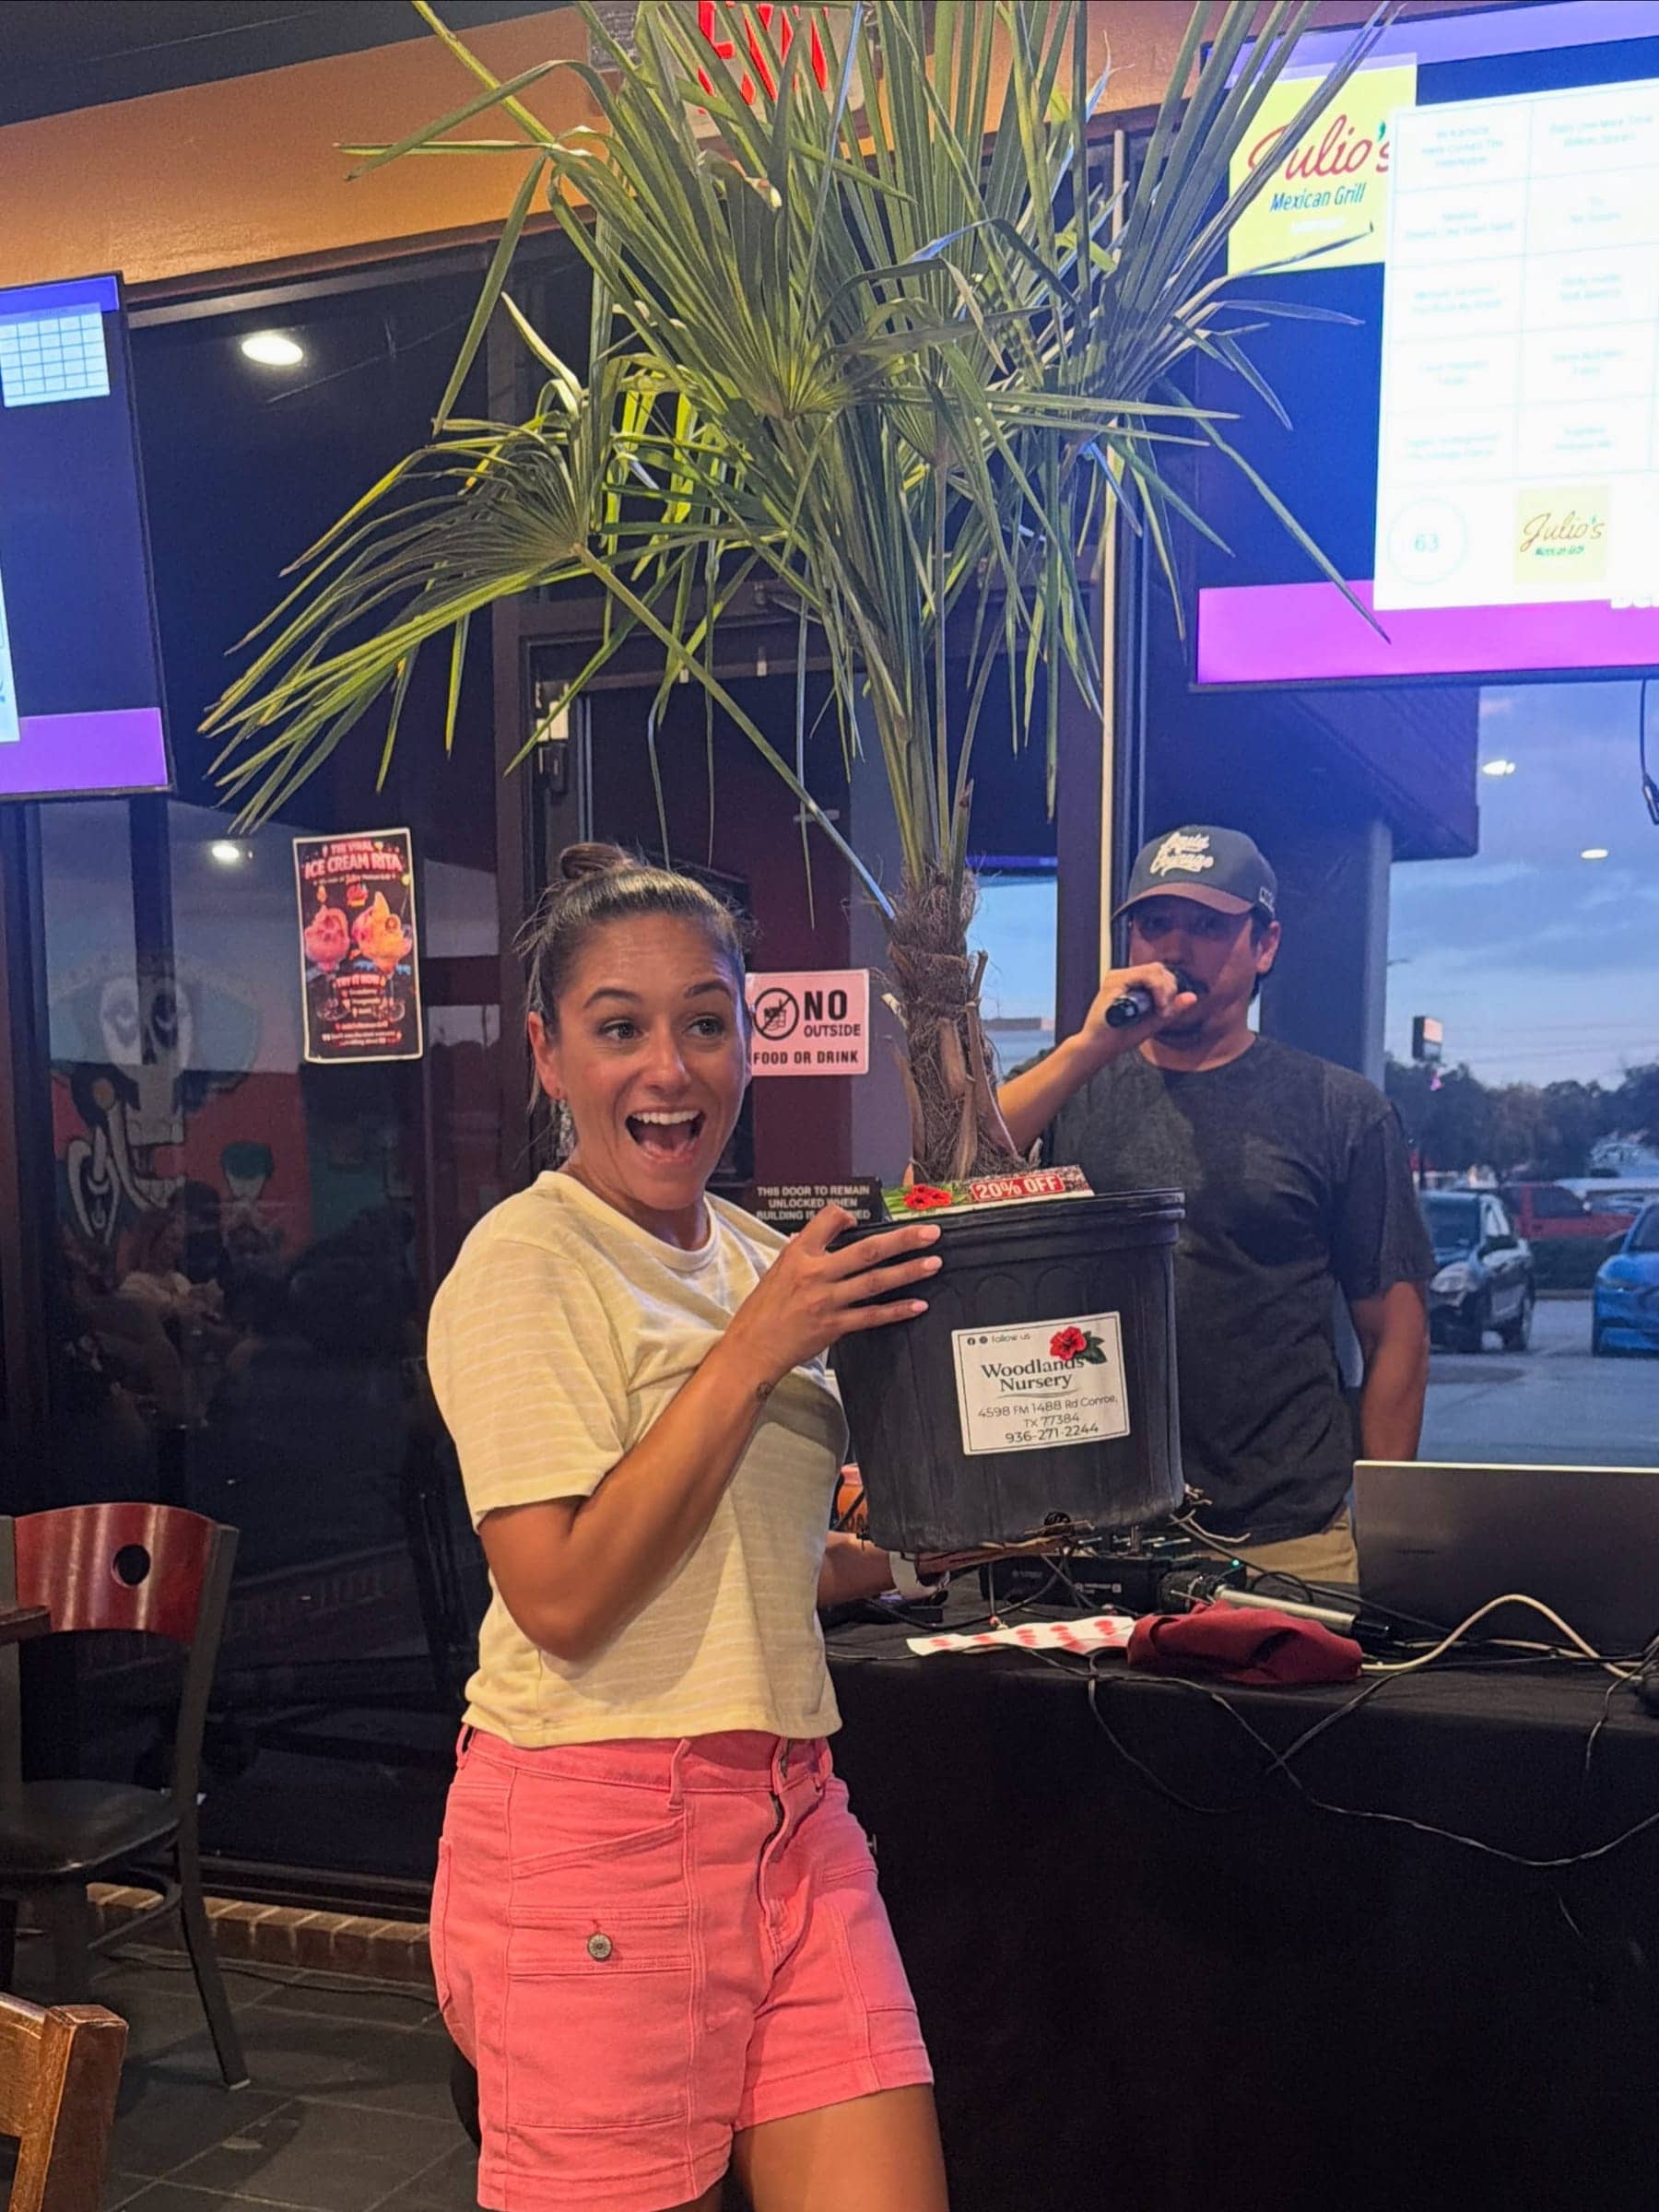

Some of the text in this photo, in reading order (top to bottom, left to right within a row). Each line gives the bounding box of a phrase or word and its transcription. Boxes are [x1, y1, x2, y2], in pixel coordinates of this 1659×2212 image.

[1270, 182, 1367, 212] Mexican Grill
[1520, 510, 1605, 552] Julio's
[1414, 533, 1440, 554] 63
[305, 852, 404, 879] ICE CREAM RITA
[804, 989, 847, 1020] NO
[804, 1024, 861, 1037] OUTSIDE
[753, 1050, 858, 1065] FOOD OR DRINK
[757, 1185, 870, 1196] THIS DOOR TO REMAIN
[975, 1175, 1061, 1198] 20% OFF
[768, 1198, 825, 1208] UNLOCKED
[756, 1210, 804, 1220] BUILDING
[981, 1357, 1085, 1379] Woodlands
[1000, 1373, 1073, 1392] Nursery
[978, 1406, 1010, 1418] 4598
[1014, 1406, 1030, 1415] FM
[1031, 1401, 1062, 1413] 1488
[1065, 1398, 1078, 1409] Rd
[1025, 1413, 1079, 1428] TX 77384
[1005, 1423, 1100, 1444] 936-271-2244
